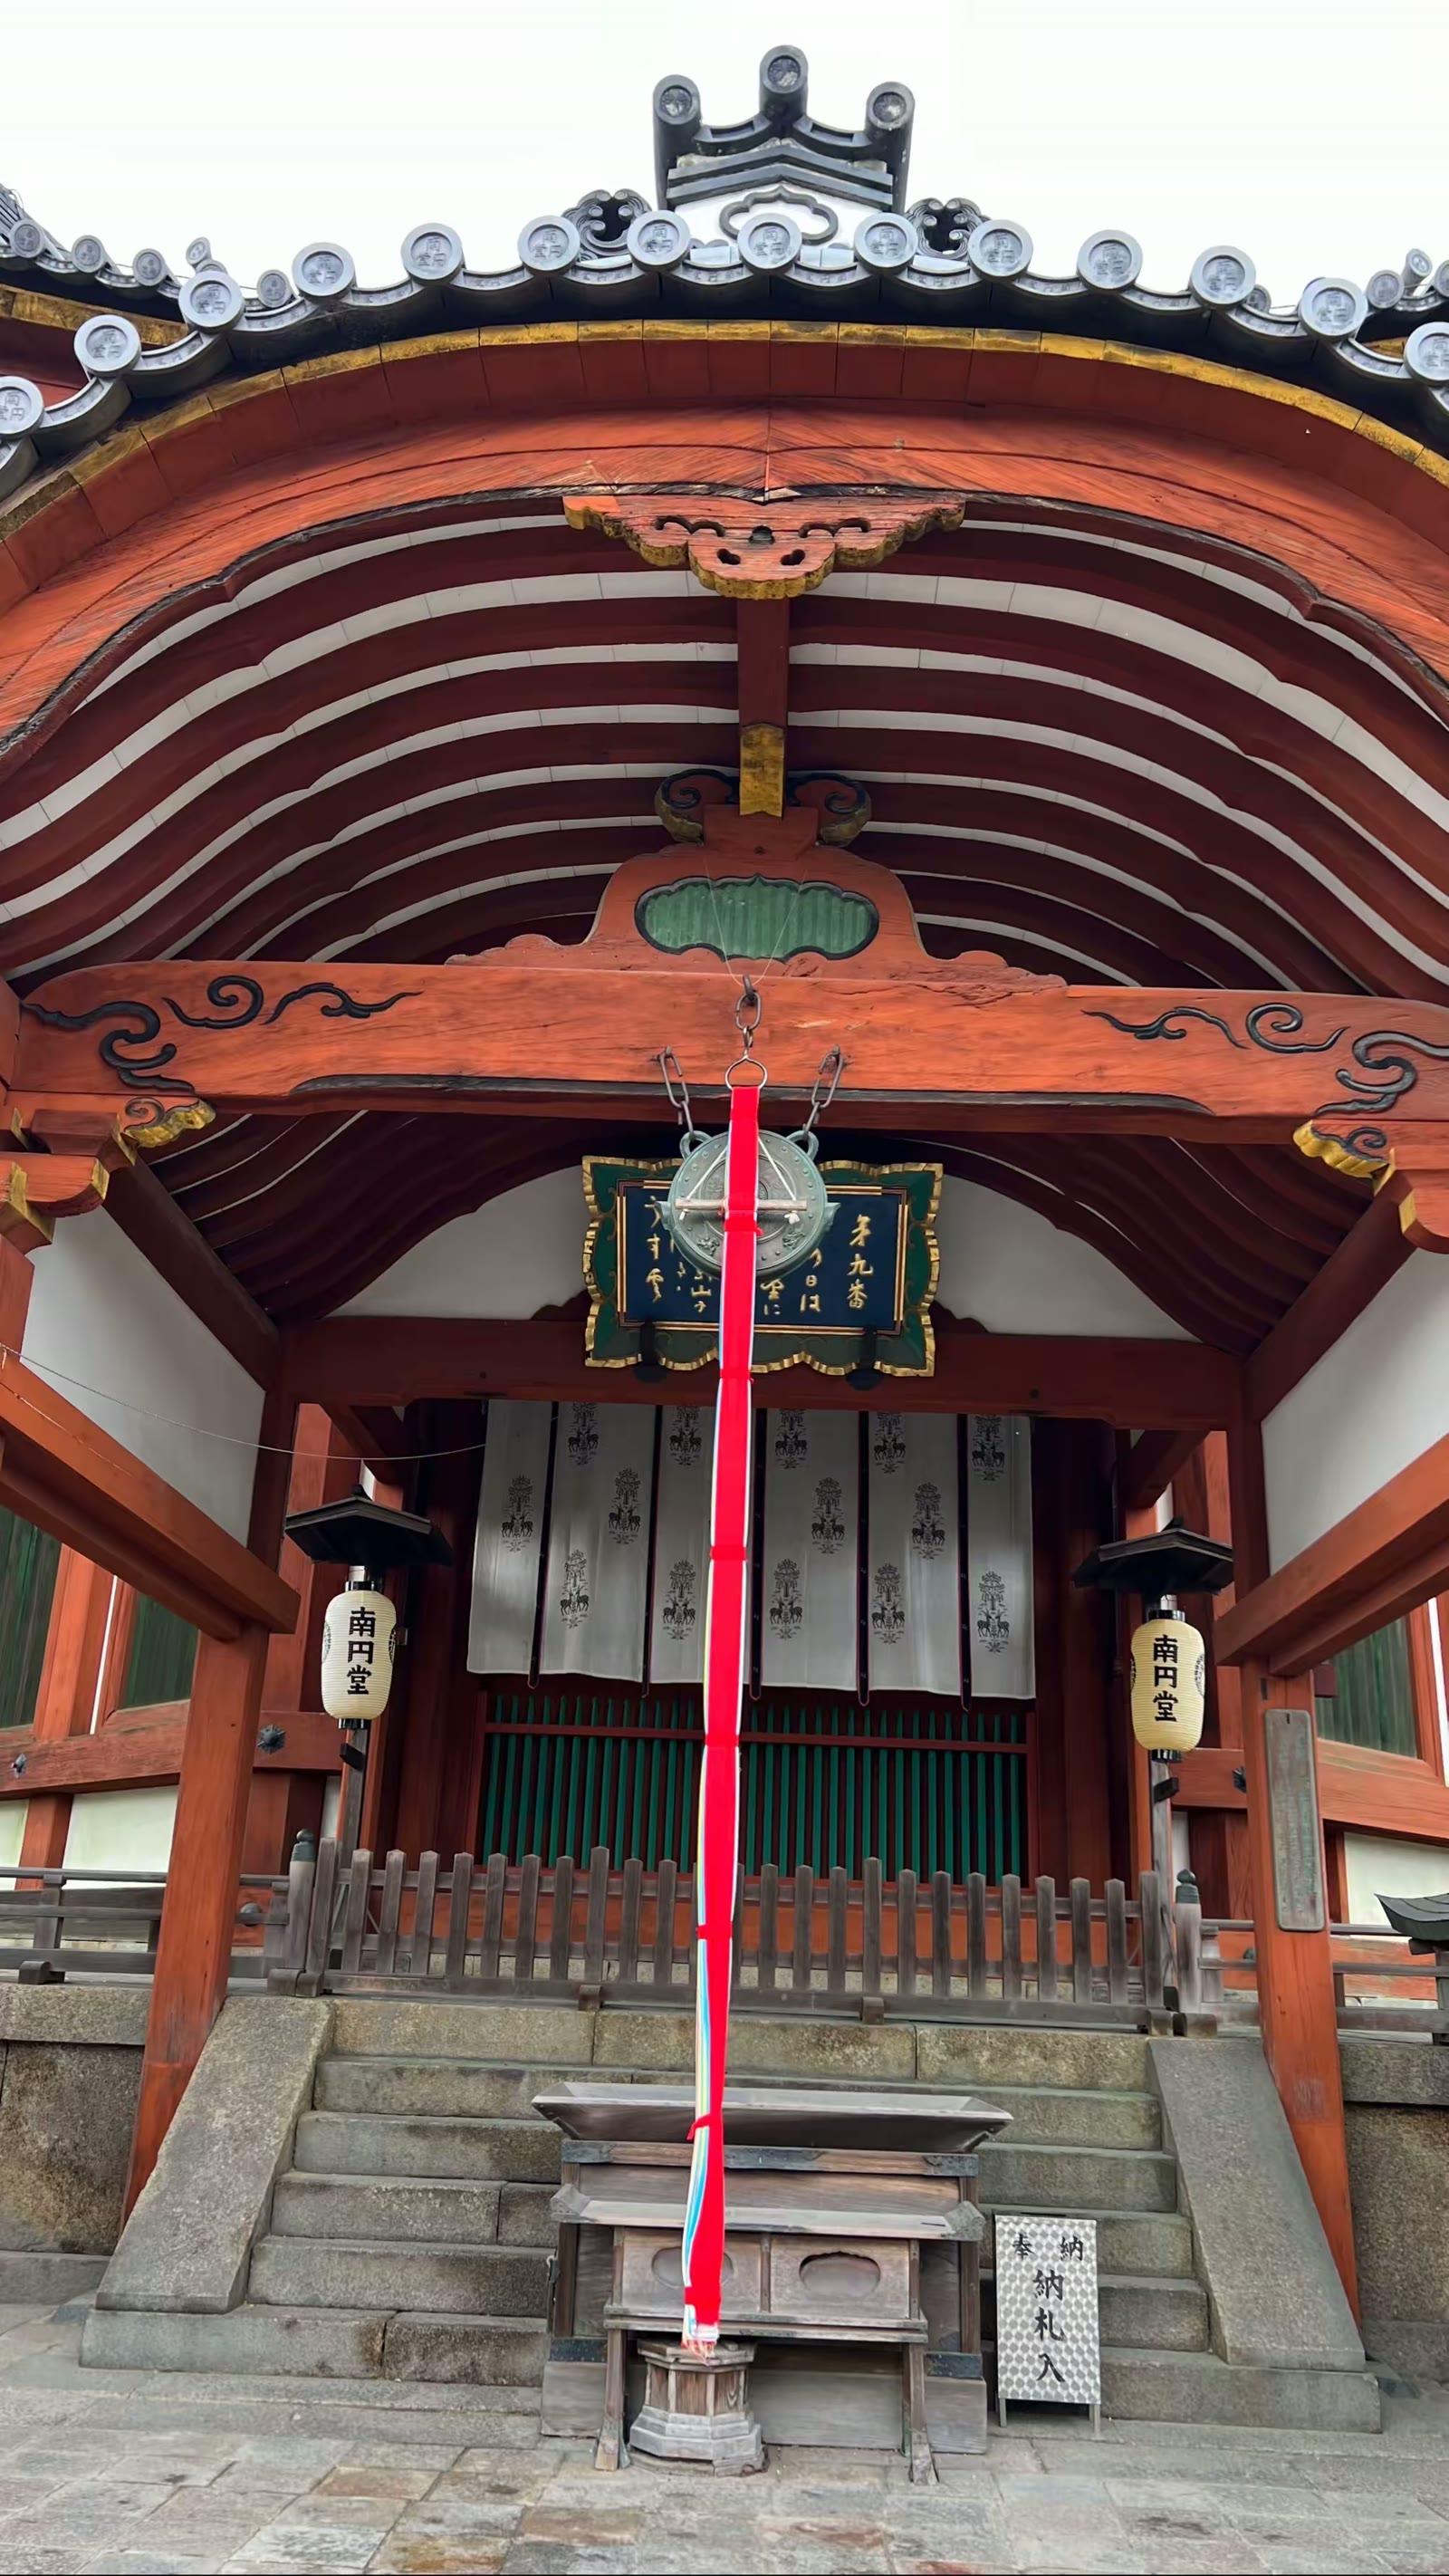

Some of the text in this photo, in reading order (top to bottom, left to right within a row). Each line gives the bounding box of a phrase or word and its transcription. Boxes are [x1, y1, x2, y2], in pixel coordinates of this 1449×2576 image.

[346, 1606, 376, 1695] 南円堂
[1153, 1634, 1178, 1722] 南円堂
[1012, 2233, 1084, 2262] 奉納
[1032, 2268, 1067, 2383] 納札入
